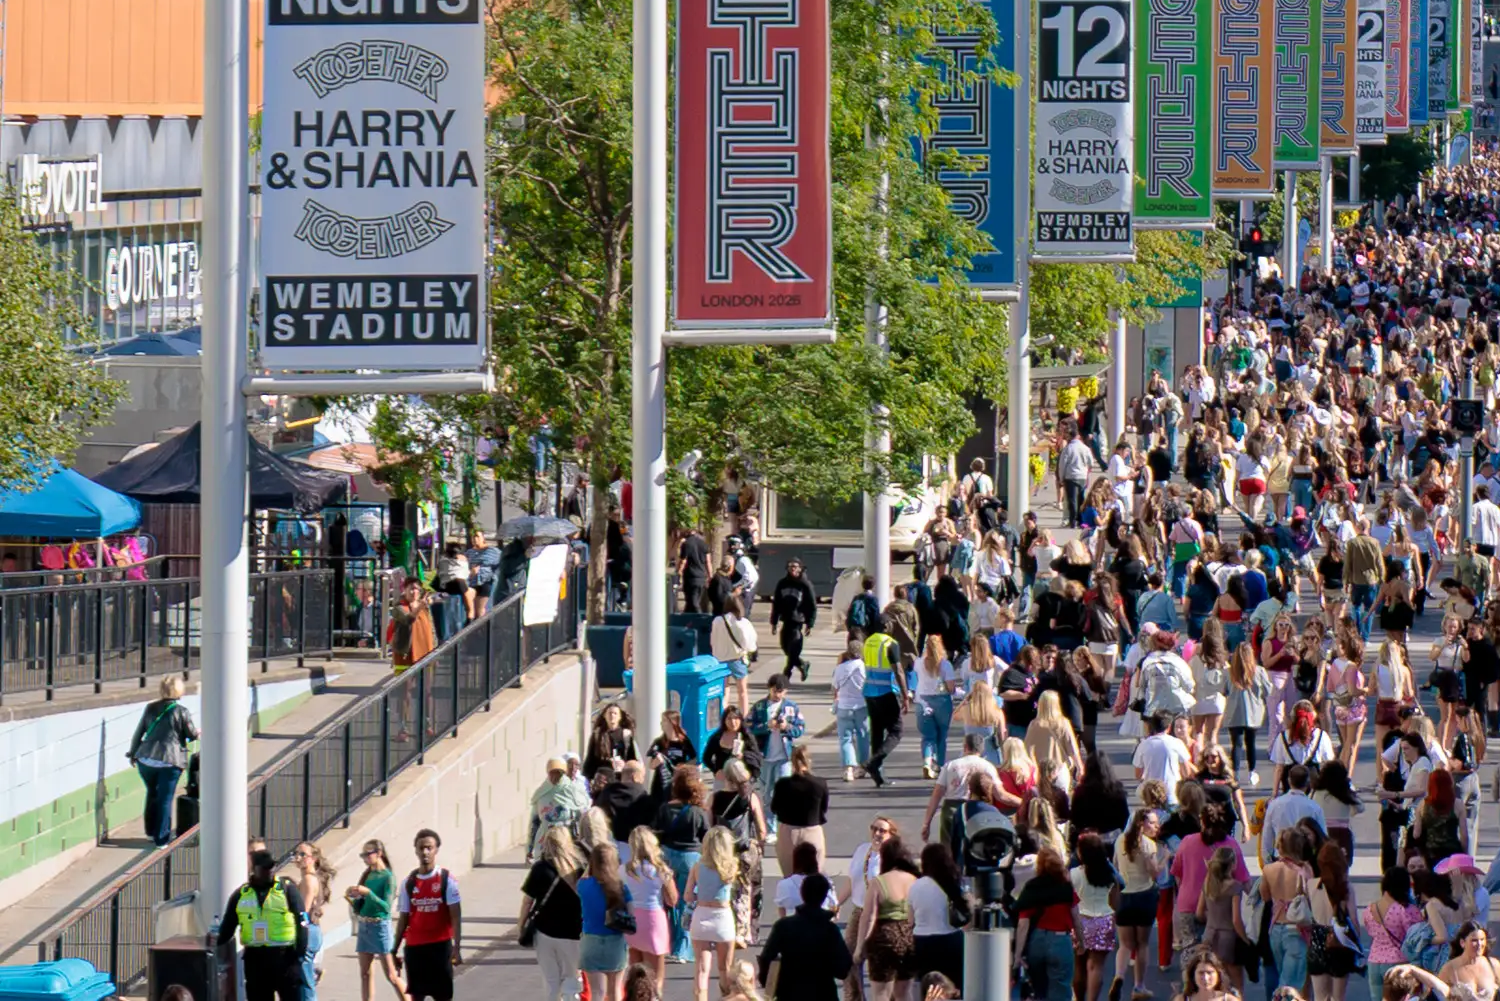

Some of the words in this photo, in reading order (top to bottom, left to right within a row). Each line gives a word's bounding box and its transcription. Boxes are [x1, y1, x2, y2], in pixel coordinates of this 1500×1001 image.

[1042, 5, 1126, 77] 12
[1358, 12, 1383, 49] 2
[1358, 50, 1382, 60] HTS
[293, 39, 449, 104] TOGETHER
[1043, 80, 1126, 99] NIGHTS
[294, 109, 456, 147] HARRY
[1049, 139, 1119, 156] HARRY
[21, 153, 107, 217] NOVOTEL
[294, 199, 456, 260] TOGETHER
[1040, 214, 1127, 227] WEMBLEY
[1040, 227, 1127, 240] STADIUM
[106, 242, 189, 310] GOURMET
[273, 281, 472, 309] WEMBLEY
[701, 294, 764, 307] LONDON
[273, 313, 470, 341] STADIUM
